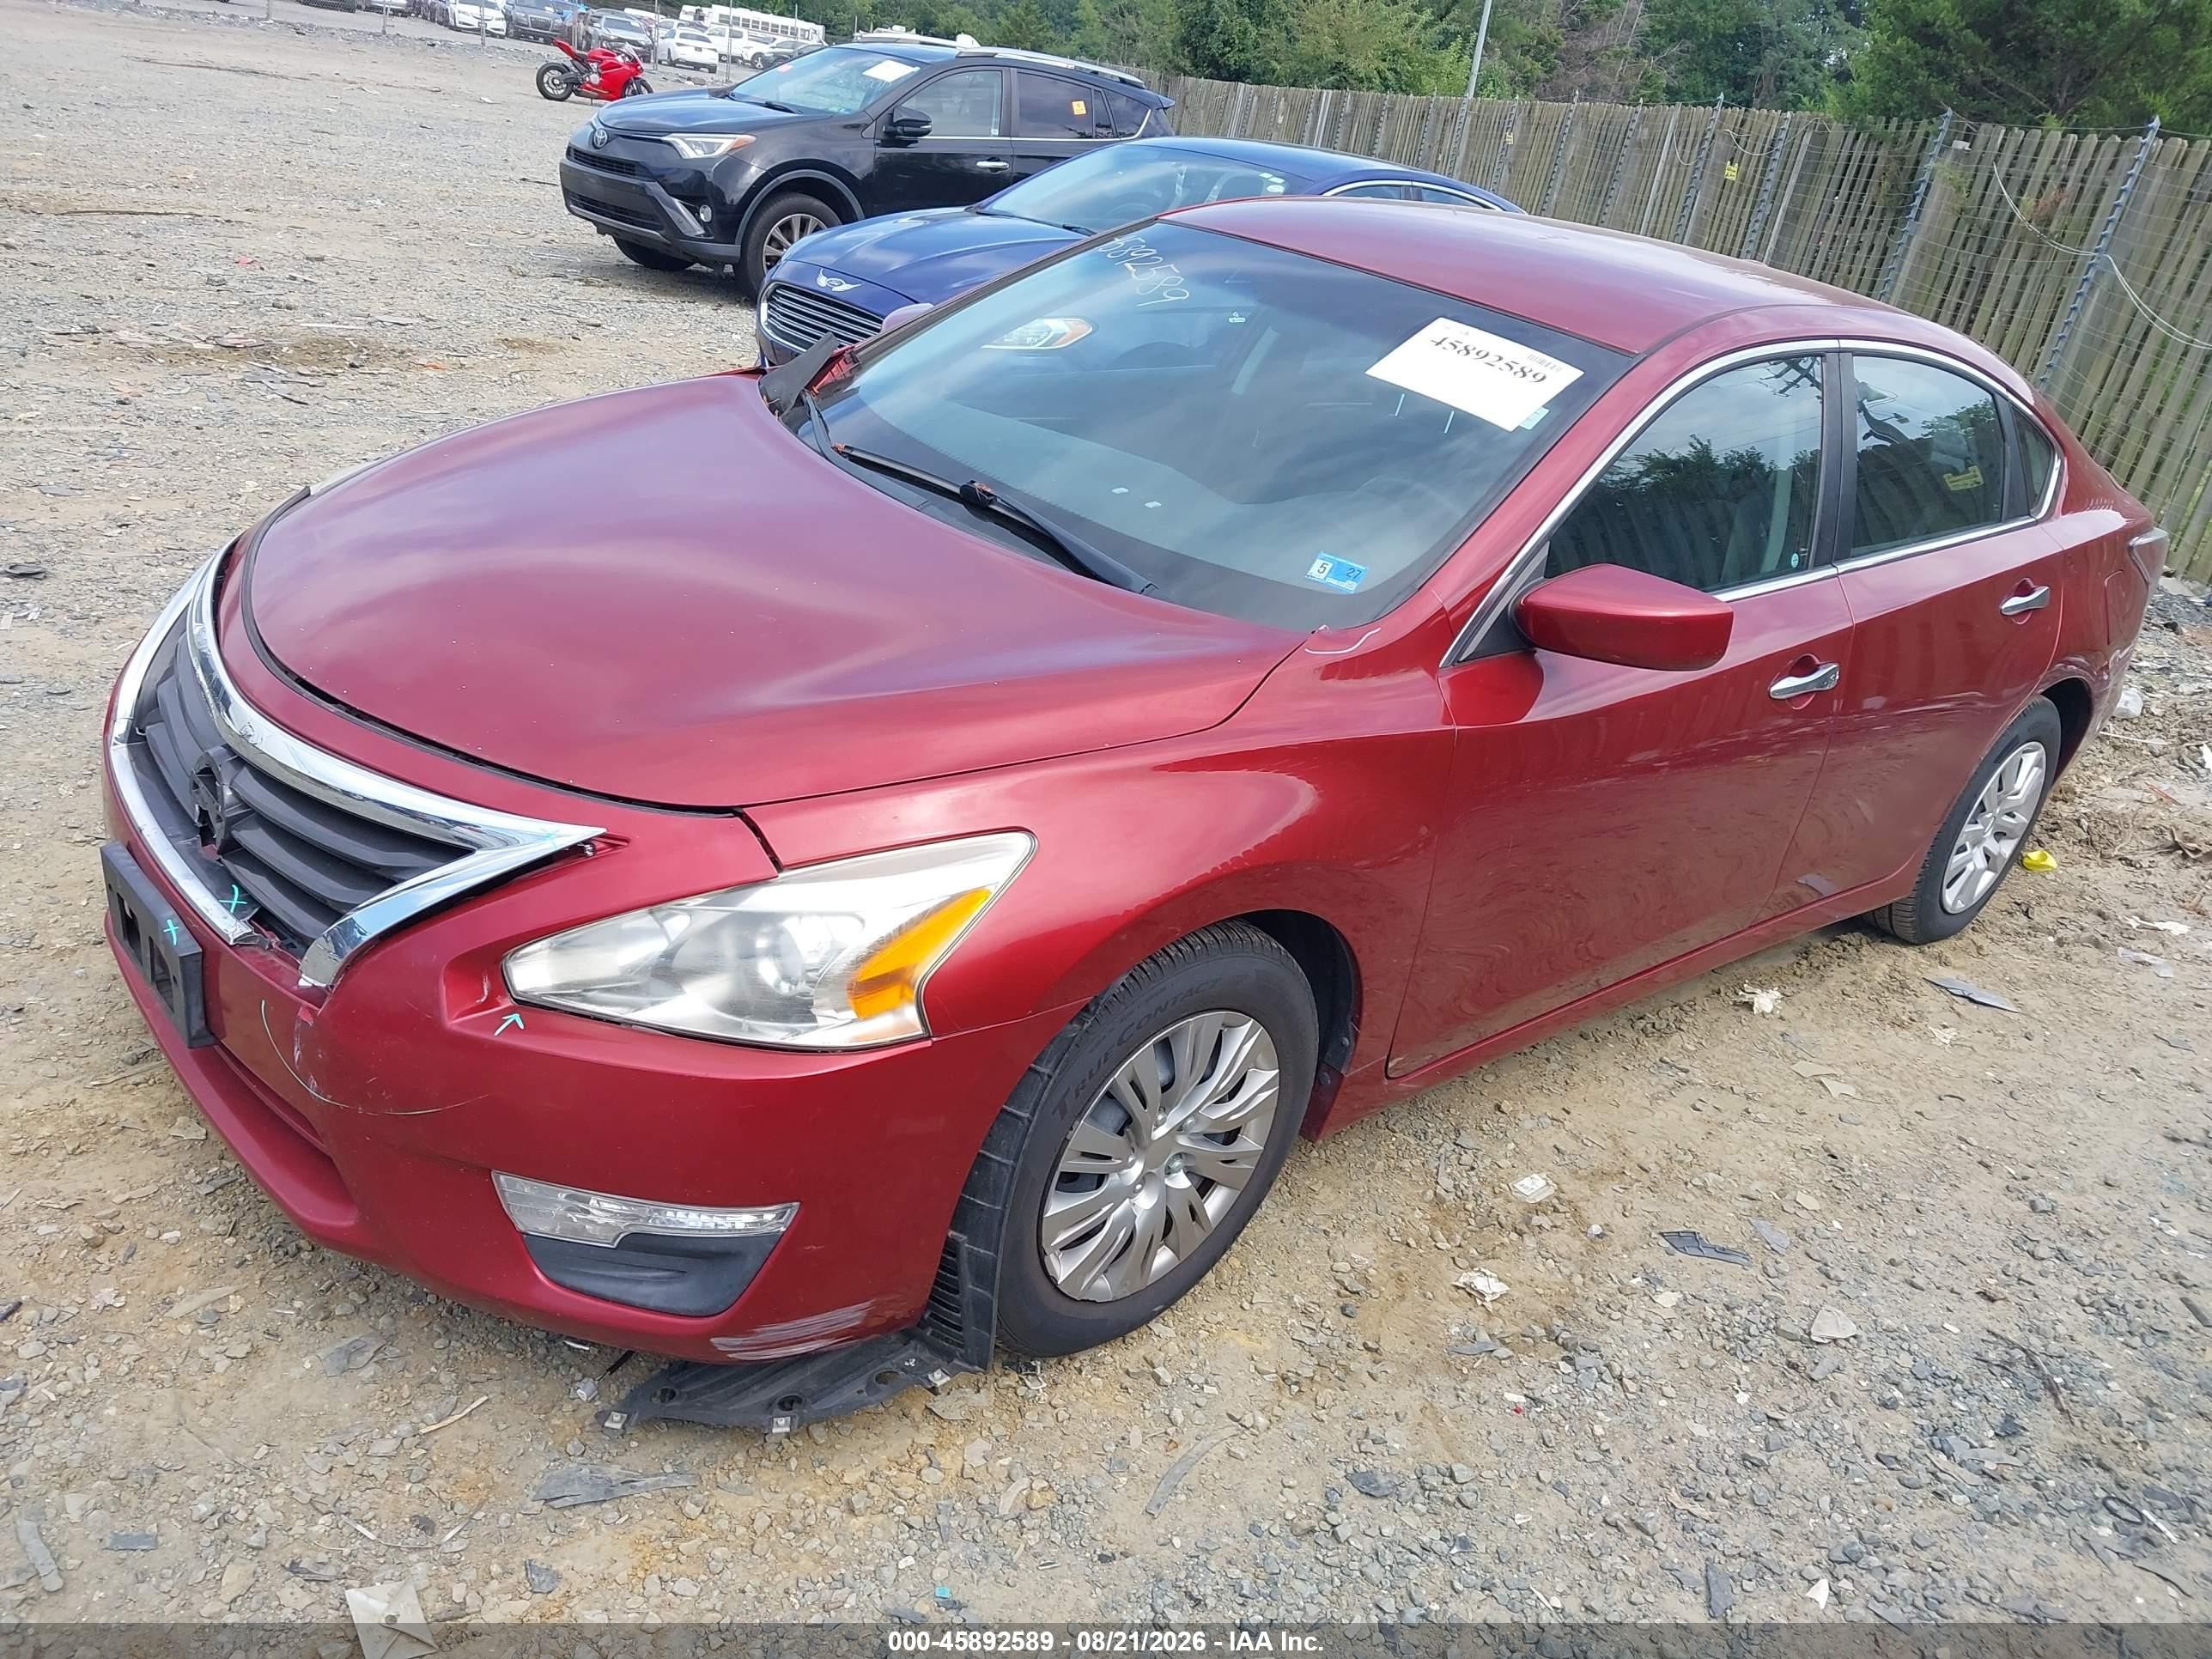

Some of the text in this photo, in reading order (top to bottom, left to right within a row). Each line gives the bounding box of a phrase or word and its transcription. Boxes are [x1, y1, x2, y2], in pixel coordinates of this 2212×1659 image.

[1098, 234, 1190, 307] 5892589
[1431, 337, 1547, 384] 45892589
[1317, 562, 1363, 580] 5 27
